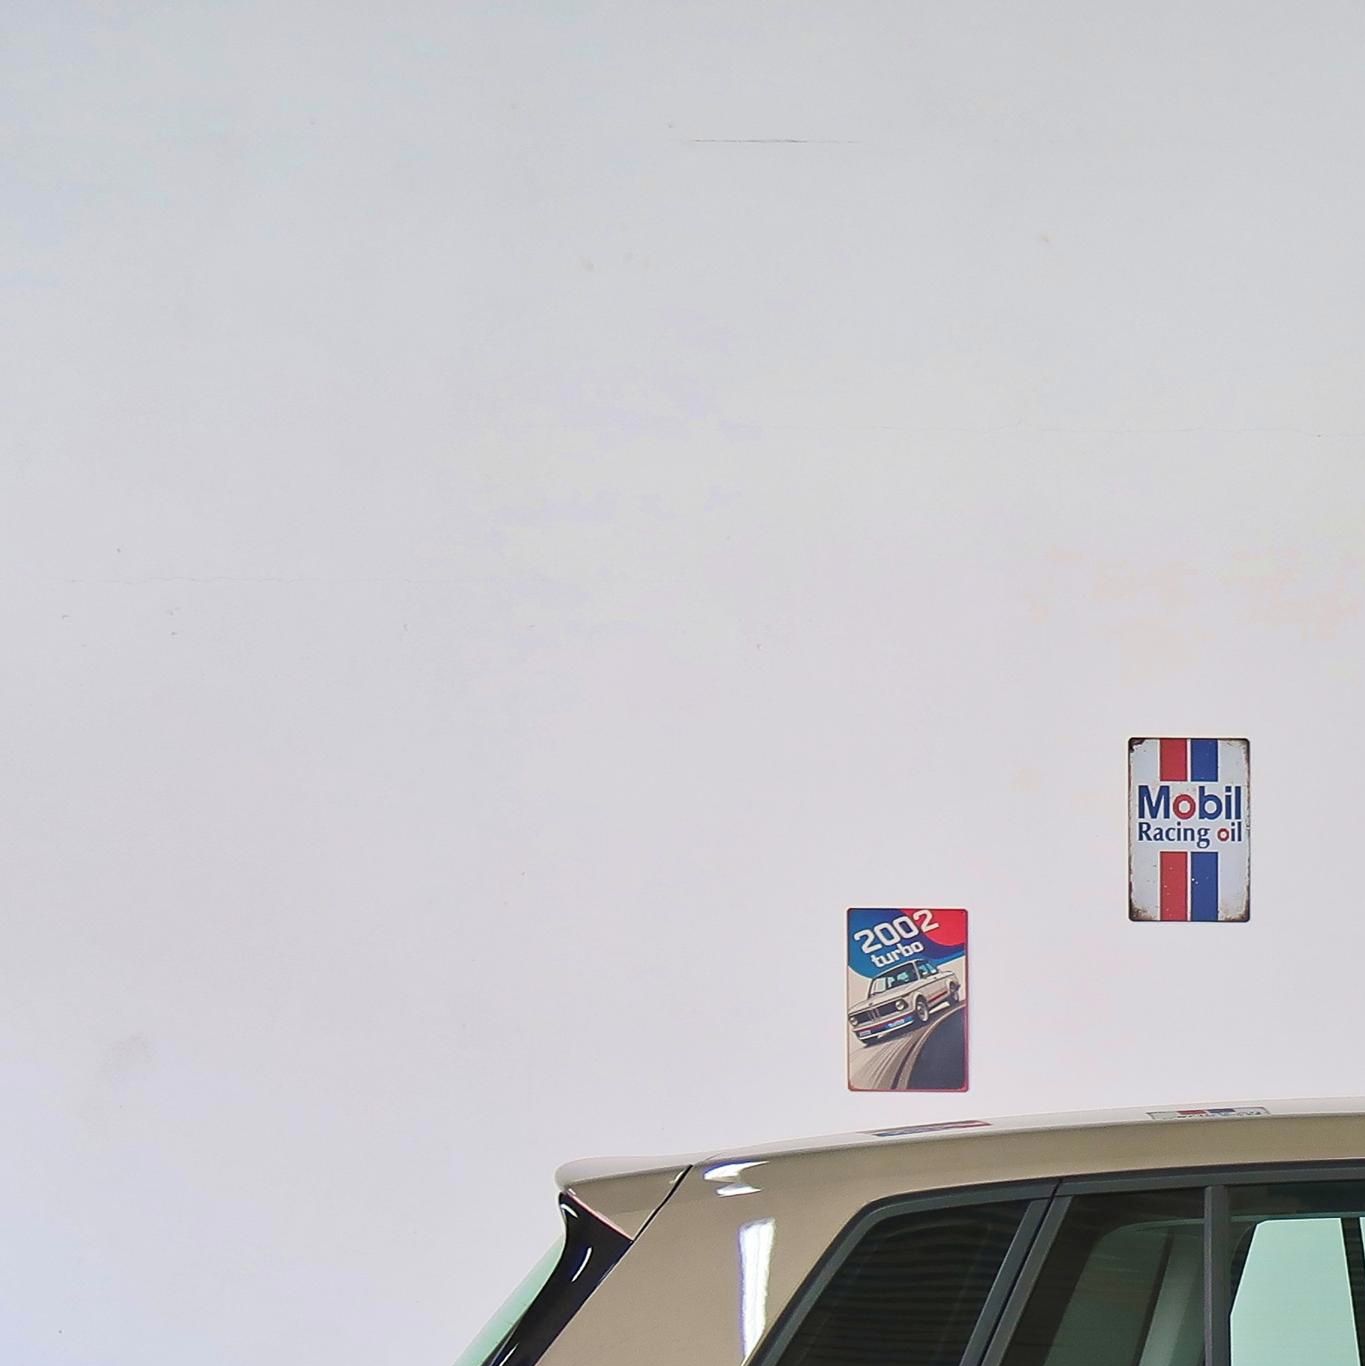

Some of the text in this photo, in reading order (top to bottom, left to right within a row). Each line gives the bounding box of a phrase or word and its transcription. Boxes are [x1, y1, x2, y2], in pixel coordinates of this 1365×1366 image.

[1138, 785, 1242, 820] Mobil
[1138, 821, 1242, 849] Racing oil
[854, 909, 940, 954] 2002
[871, 941, 924, 968] turbo
